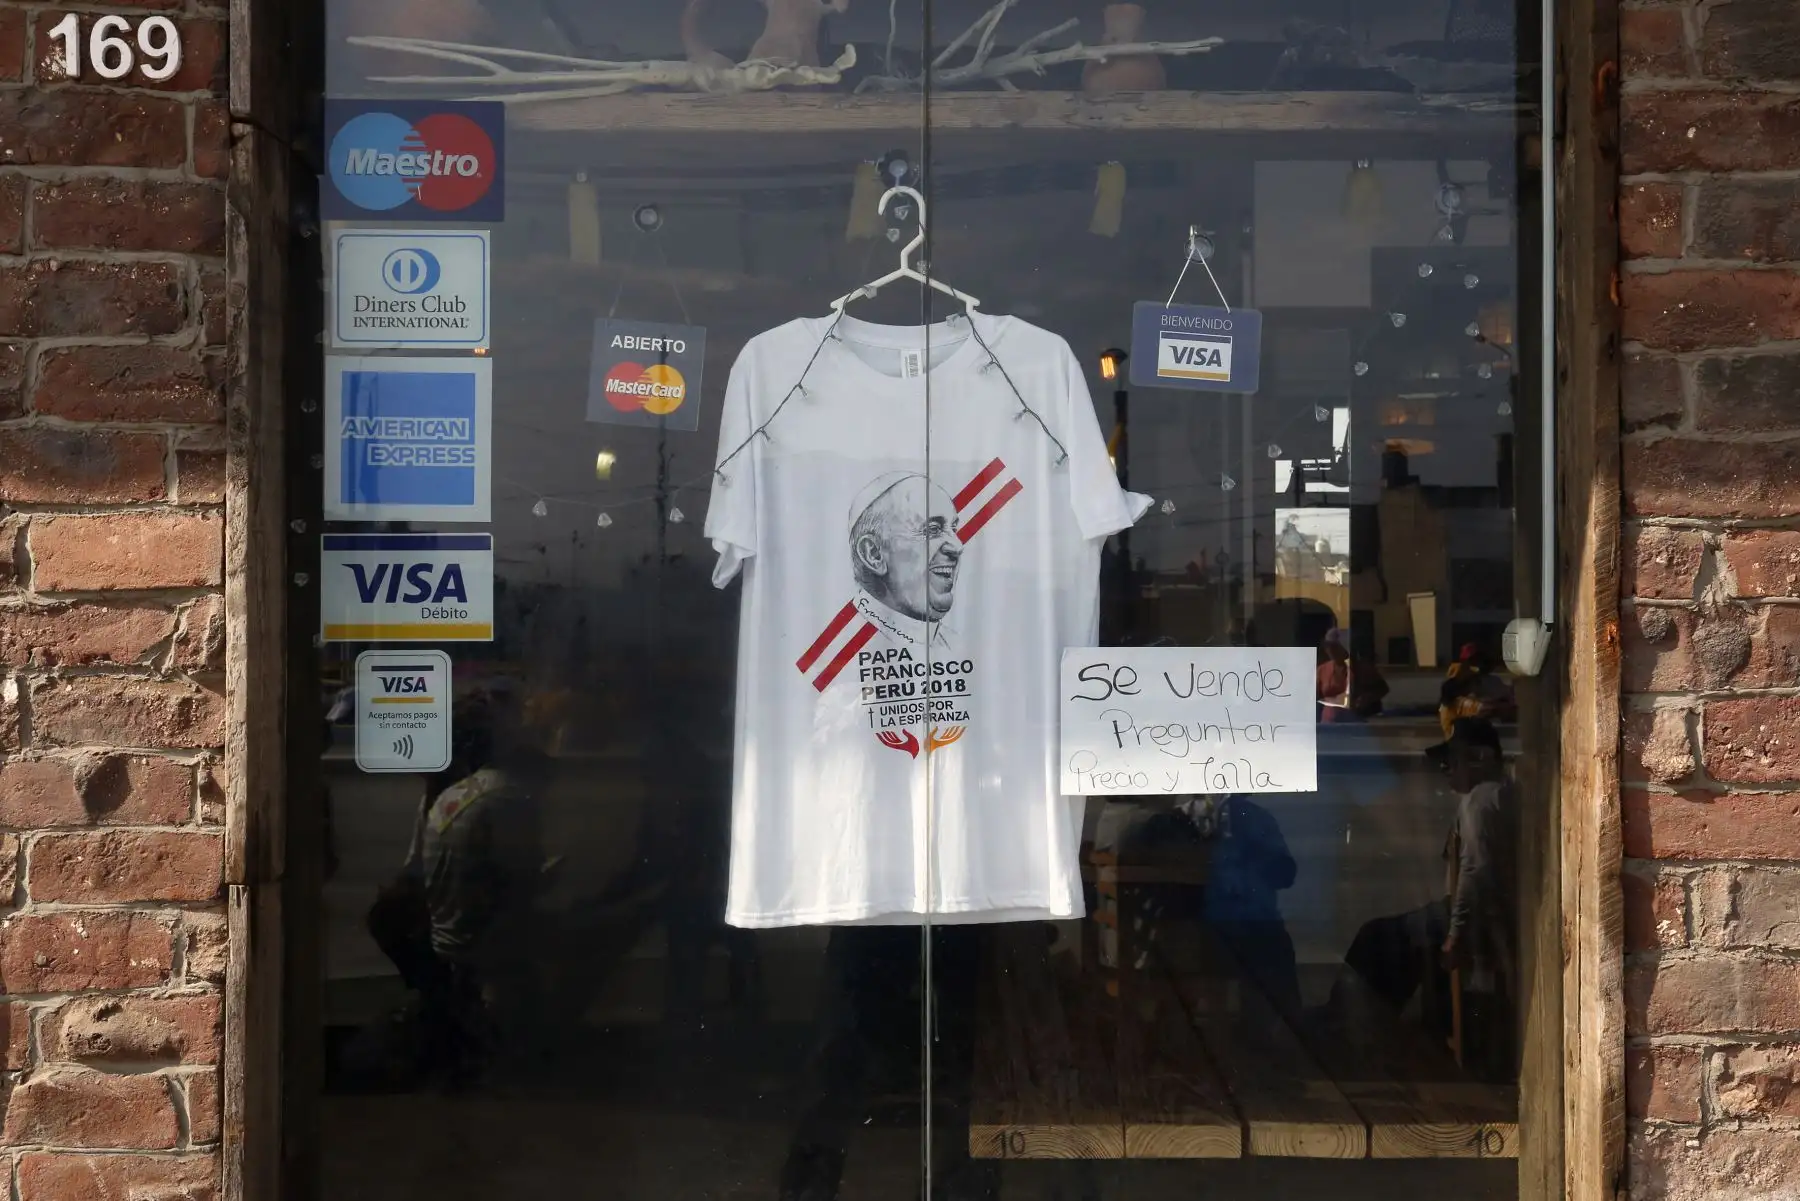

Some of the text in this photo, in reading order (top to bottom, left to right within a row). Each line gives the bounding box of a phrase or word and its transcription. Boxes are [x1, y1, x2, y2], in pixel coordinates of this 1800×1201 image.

[48, 13, 182, 81] 169
[344, 147, 480, 177] Maestro
[354, 295, 467, 313] Diners Club
[353, 316, 469, 329] INTERNATIONAL
[1161, 314, 1233, 331] BIENVENIDO
[610, 334, 686, 354] ABIERTO
[1168, 345, 1222, 367] VISA
[605, 379, 683, 398] MasterCard
[341, 418, 467, 438] AMERICAN
[369, 446, 475, 464] EXPRESS
[341, 562, 468, 604] VISA
[421, 606, 468, 620] Débito
[858, 647, 913, 666] PAPA
[859, 659, 974, 682] FRANCISCO
[377, 676, 427, 693] VISA
[861, 678, 967, 701] PERÚ 2018
[1070, 660, 1292, 702] Se Vende
[368, 711, 438, 720] Aceptamos pagos
[880, 700, 954, 716] UNIDOS POR
[392, 721, 427, 729] contacto
[880, 710, 971, 728] LA ESPERANZA
[1099, 707, 1287, 758] Preguntar
[1069, 749, 1149, 792] Precio
